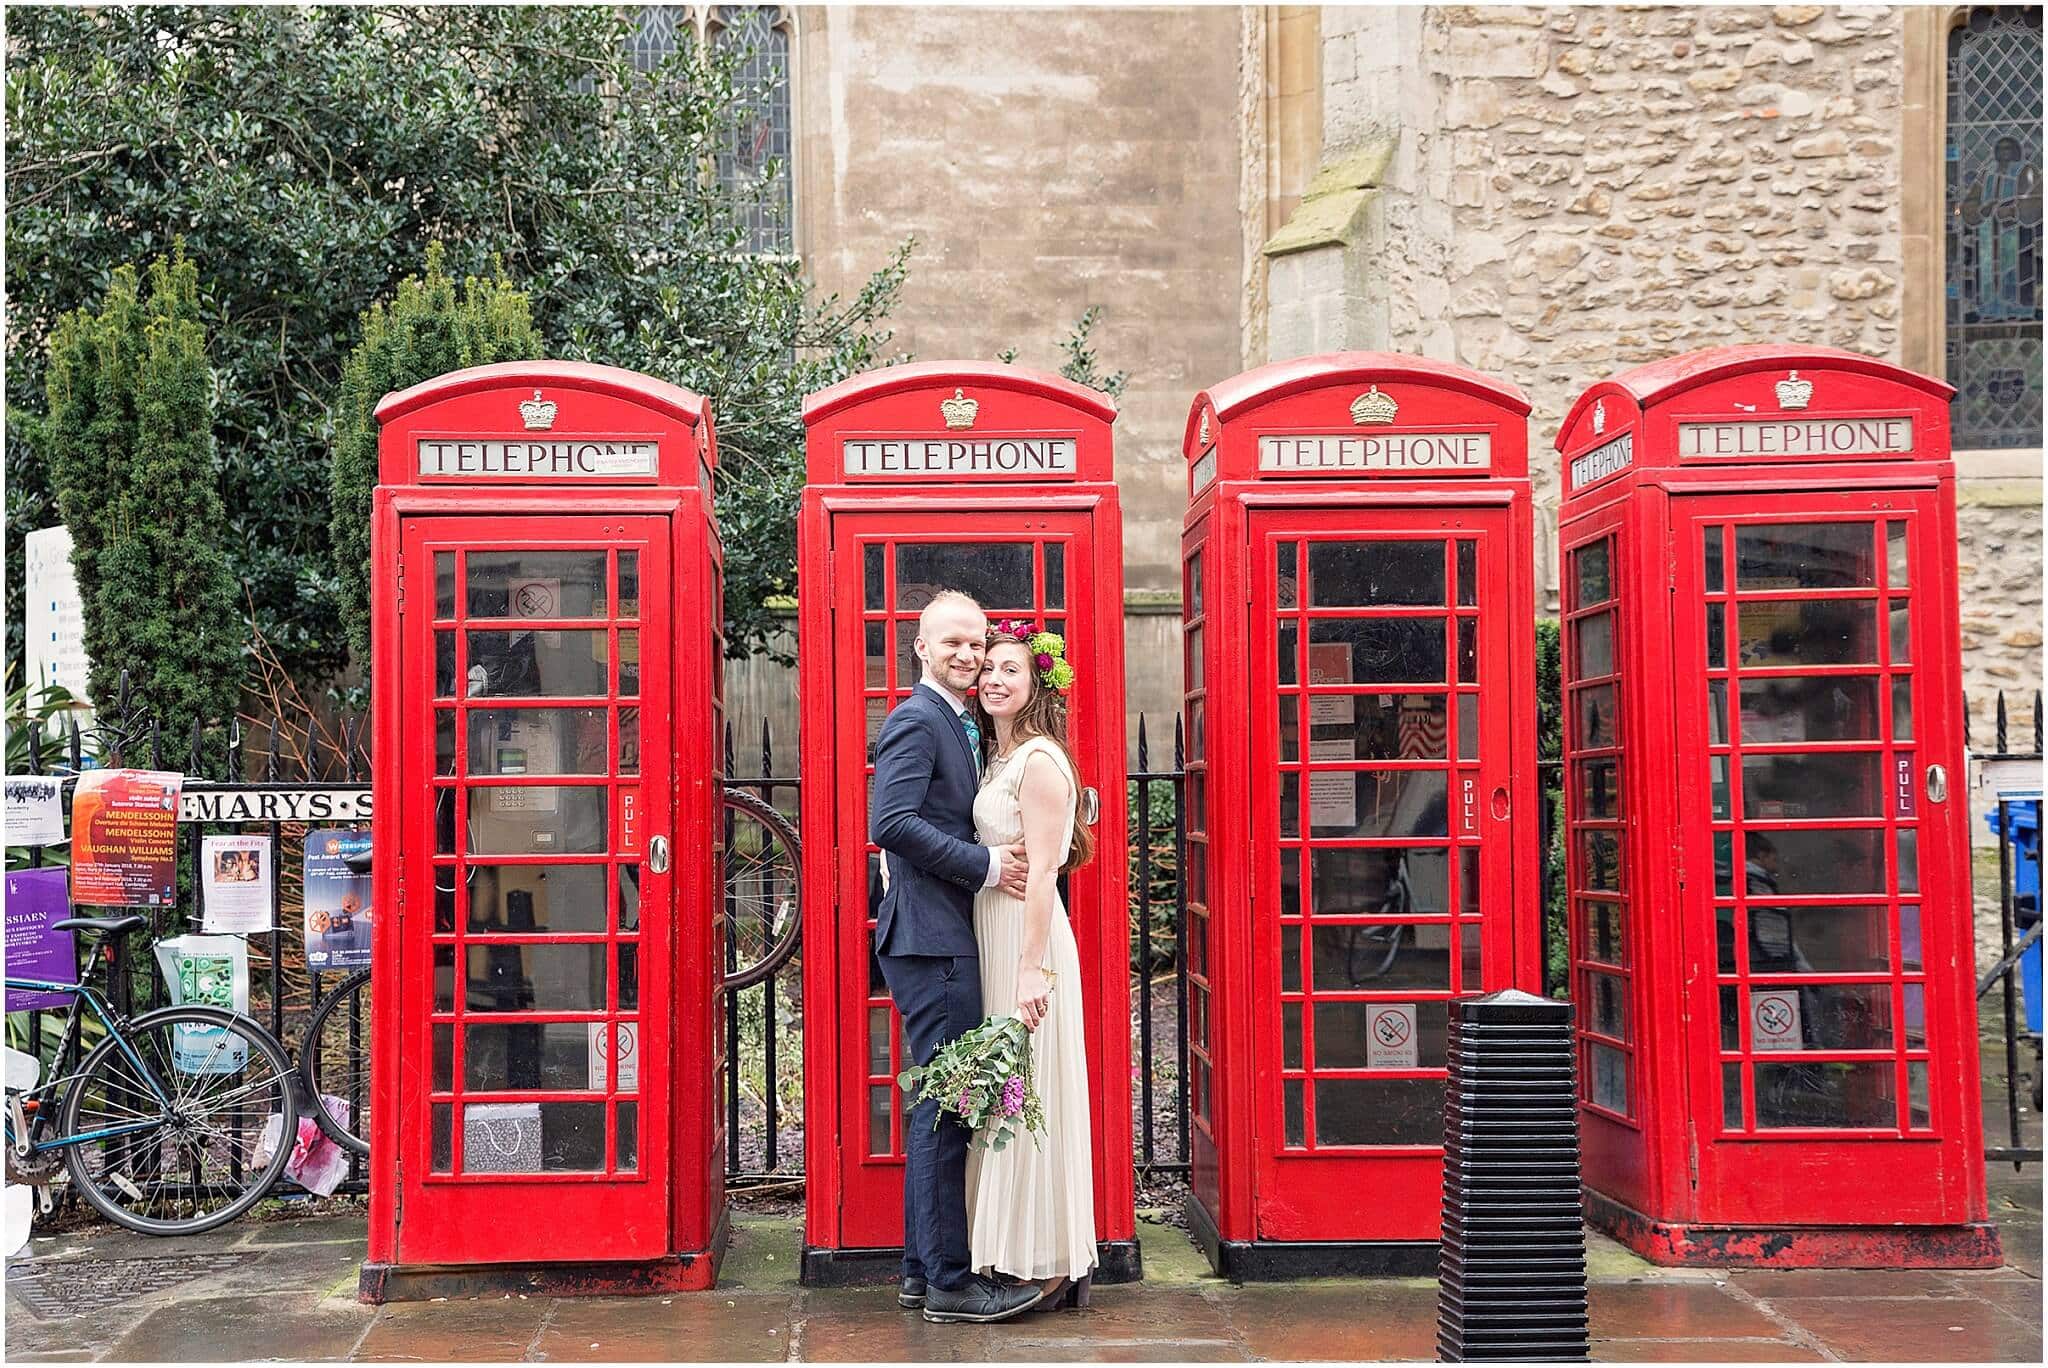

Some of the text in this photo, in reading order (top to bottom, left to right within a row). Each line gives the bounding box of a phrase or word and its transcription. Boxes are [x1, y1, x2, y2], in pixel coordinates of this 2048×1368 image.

[1269, 437, 1480, 467] TELEPHONE
[1687, 421, 1902, 455] TELEPHONE
[852, 441, 1066, 471] TELEPHONE
[1574, 436, 1632, 488] TELEPHONE
[1899, 760, 1911, 810] PULL
[105, 810, 174, 821] MENDELSSOHN
[194, 793, 332, 821] MARYS
[1463, 779, 1475, 830] PULL
[105, 828, 174, 839] MENDELSSOHN
[624, 795, 634, 847] PULL
[80, 844, 174, 856] VAUGHAN WILLIAMS
